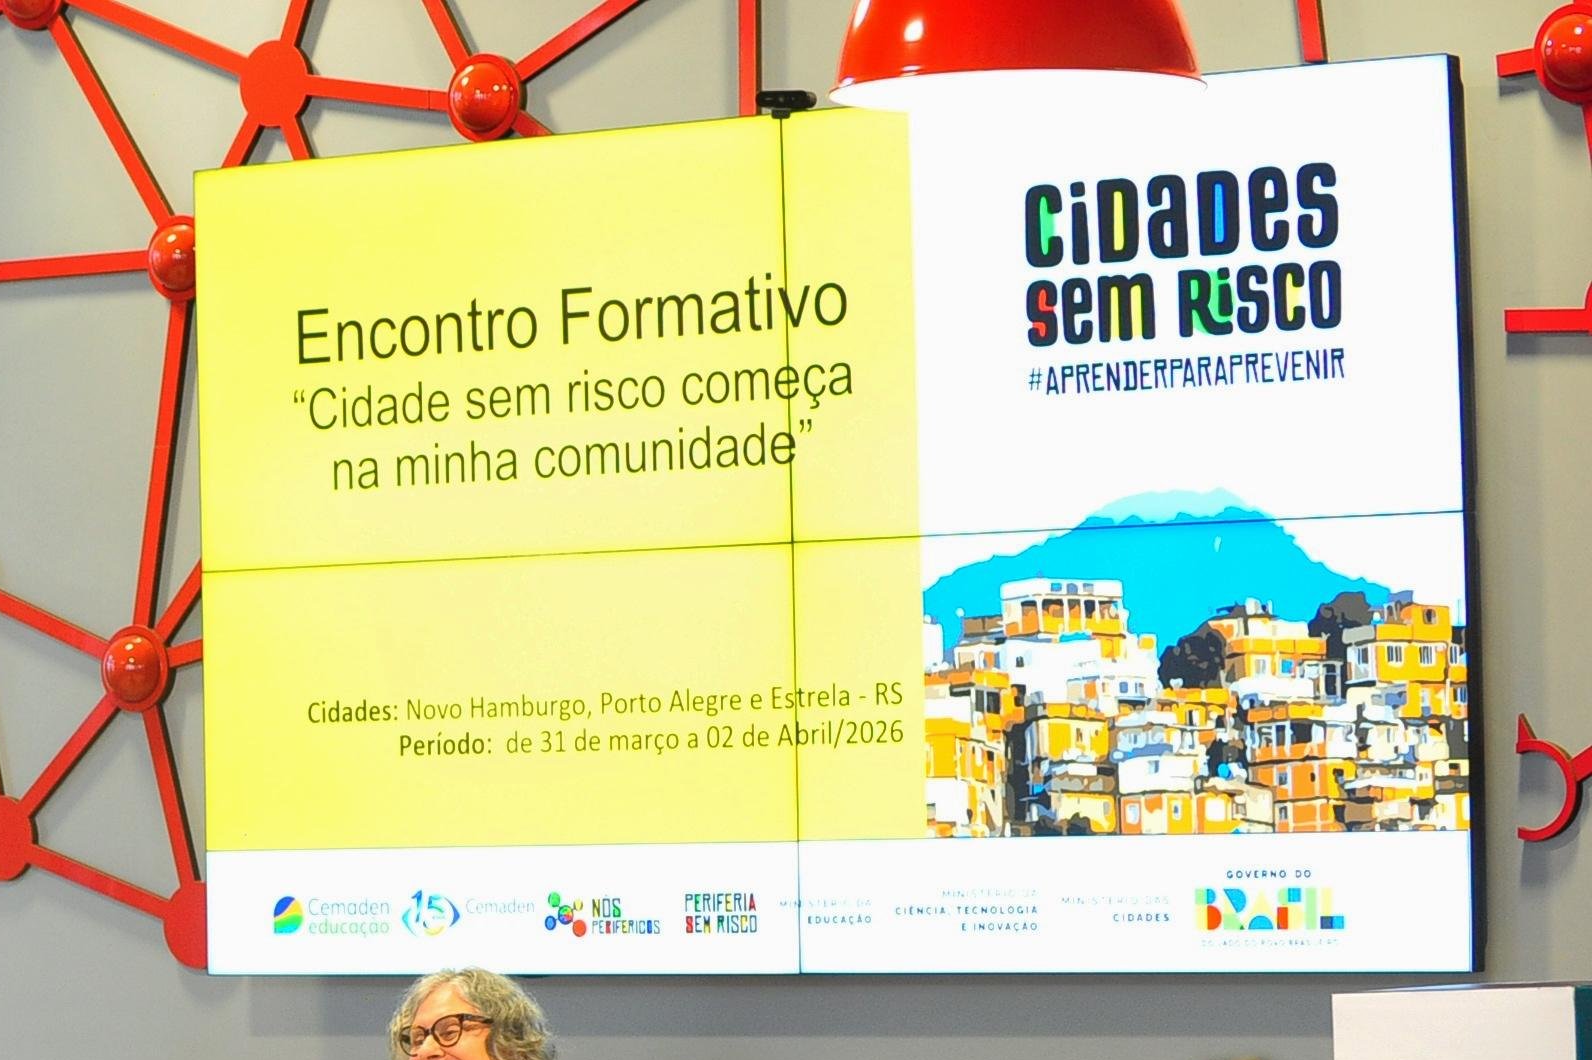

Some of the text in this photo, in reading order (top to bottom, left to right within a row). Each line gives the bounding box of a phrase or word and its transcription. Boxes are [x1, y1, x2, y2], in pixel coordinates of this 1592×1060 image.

[297, 272, 847, 364] Encontro Formativo
[1028, 348, 1345, 395] #APRENDERPARAPREVENIR
[293, 362, 852, 430] “Cidade sem risco começa
[332, 419, 813, 490] na minha comunidade”
[308, 699, 398, 723] Cidades:
[407, 699, 462, 720] Novo
[471, 694, 592, 721] Hamburgo,
[601, 691, 661, 714] Porto
[670, 688, 742, 716] Alegre
[750, 693, 763, 710] e
[772, 683, 850, 709] Estrela
[876, 682, 903, 705] RS
[399, 719, 904, 756] Período: de 31 de março a 02 de Abril/2026
[1226, 869, 1312, 879] GOVERNO DO
[308, 898, 390, 916] Cemaden
[465, 898, 535, 914] Cemaden
[685, 893, 756, 912] PERIFERIA
[957, 905, 1038, 915] TECNOLOGIA
[1195, 887, 1344, 930] BRASIL
[686, 915, 757, 933] SEM RISCO
[808, 913, 872, 925] EDUCAÇÃO
[961, 921, 1038, 933] E INOVAÇÃO
[1112, 913, 1169, 923] CIDADES
[309, 919, 390, 938] educação
